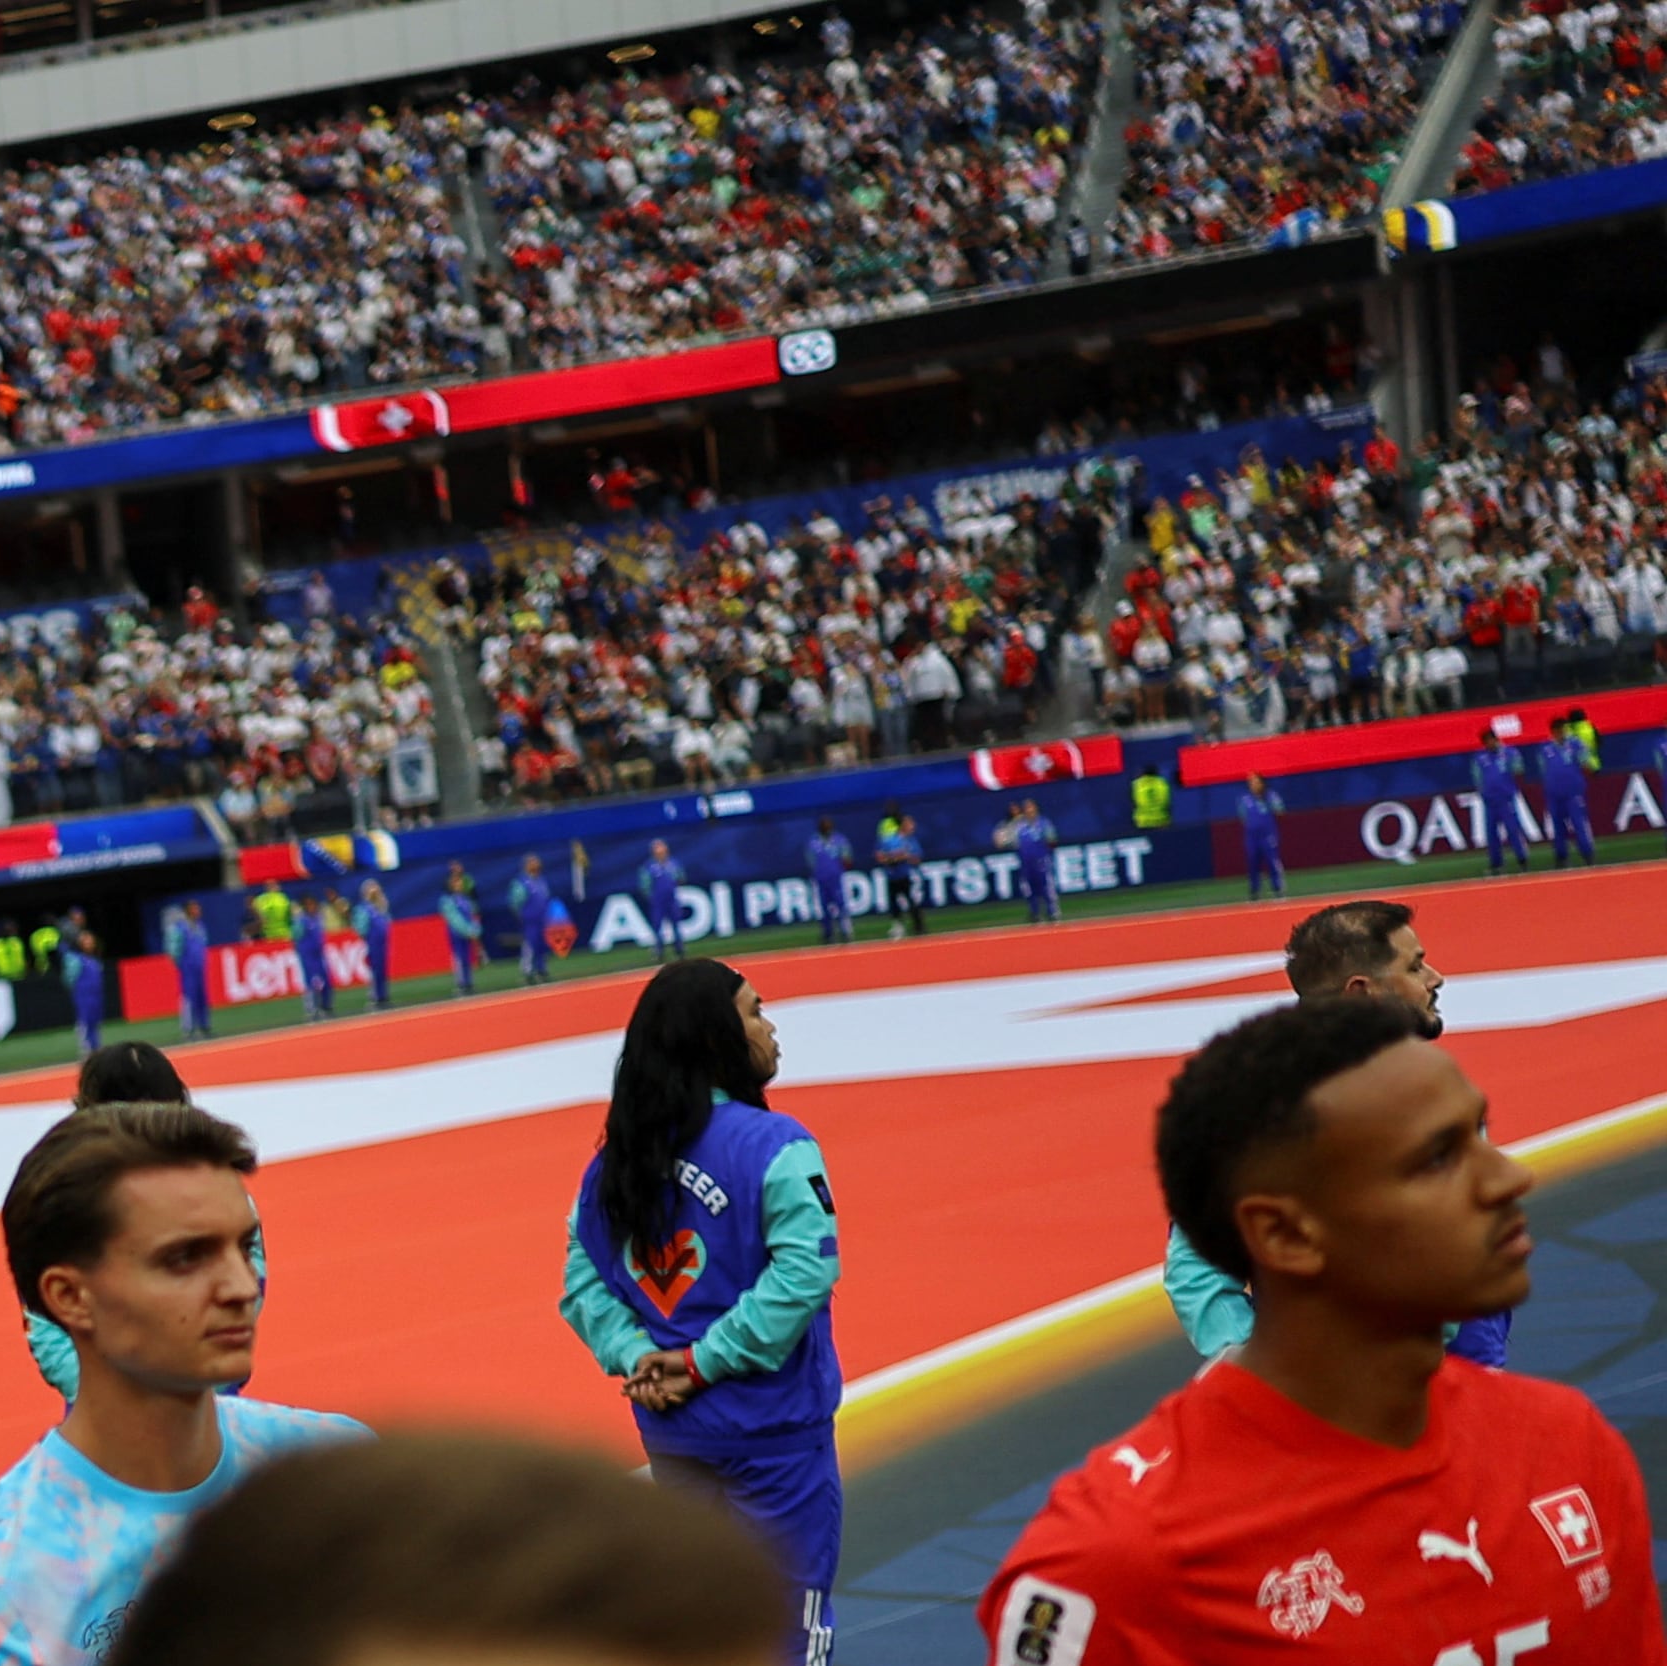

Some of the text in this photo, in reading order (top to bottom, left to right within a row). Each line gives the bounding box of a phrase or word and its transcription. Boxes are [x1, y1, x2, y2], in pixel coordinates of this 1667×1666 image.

[1360, 790, 1555, 864] QATA
[743, 836, 1152, 930] PRDITSTEET
[220, 938, 370, 1002] Lenvo
